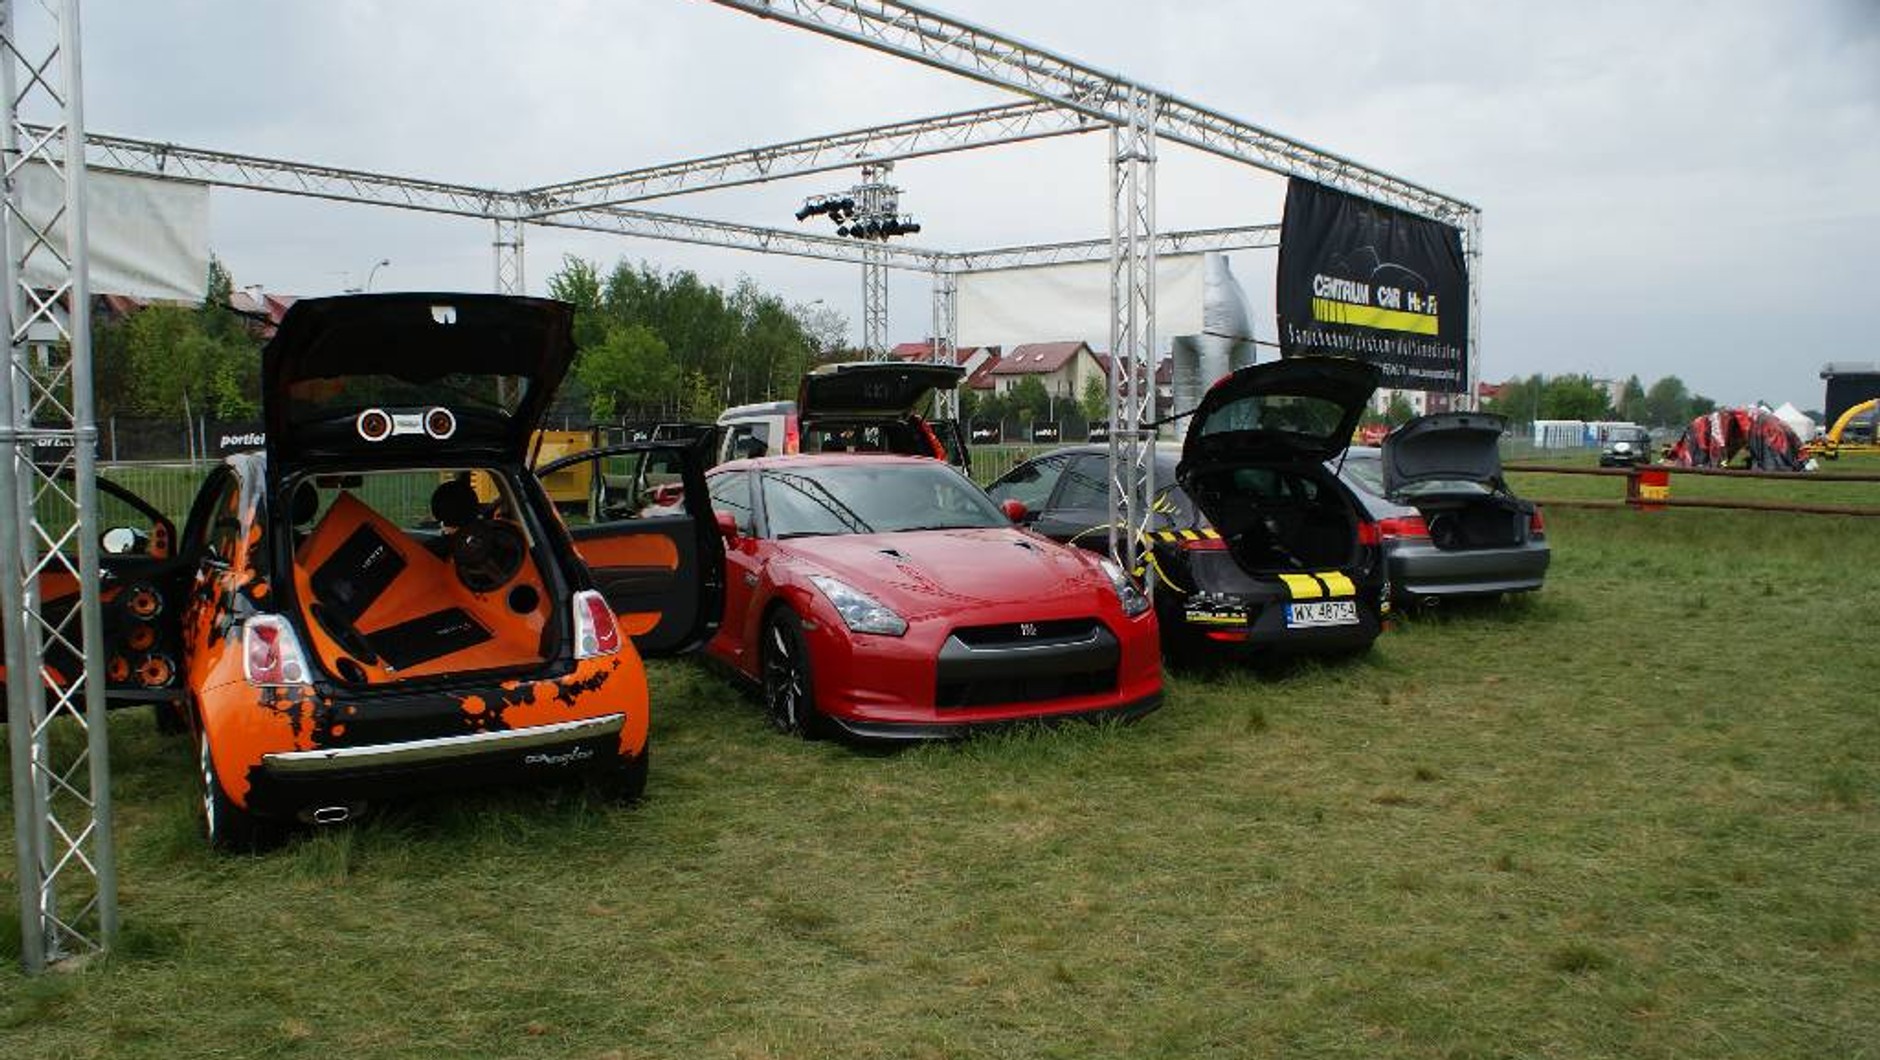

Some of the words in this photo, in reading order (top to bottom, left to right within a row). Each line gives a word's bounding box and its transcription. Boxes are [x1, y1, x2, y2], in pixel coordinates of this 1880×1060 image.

[1313, 274, 1369, 304] CENTRUM
[1377, 286, 1401, 309] CAR
[1294, 604, 1314, 620] WX
[1318, 603, 1354, 618] 48754
